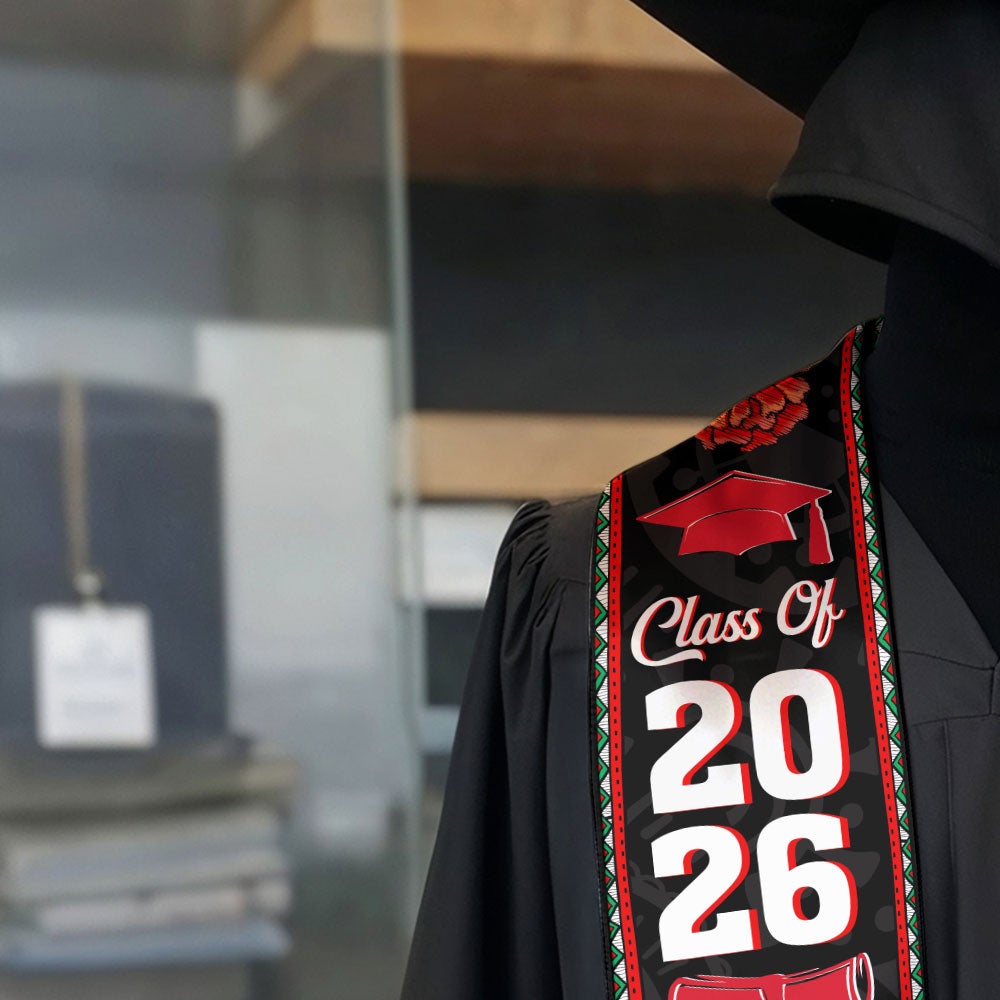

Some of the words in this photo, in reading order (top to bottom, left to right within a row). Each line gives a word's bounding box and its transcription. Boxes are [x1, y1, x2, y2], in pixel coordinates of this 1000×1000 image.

[631, 595, 763, 667] Class
[776, 577, 847, 649] Of
[645, 668, 851, 814] 20
[651, 813, 858, 962] 26
